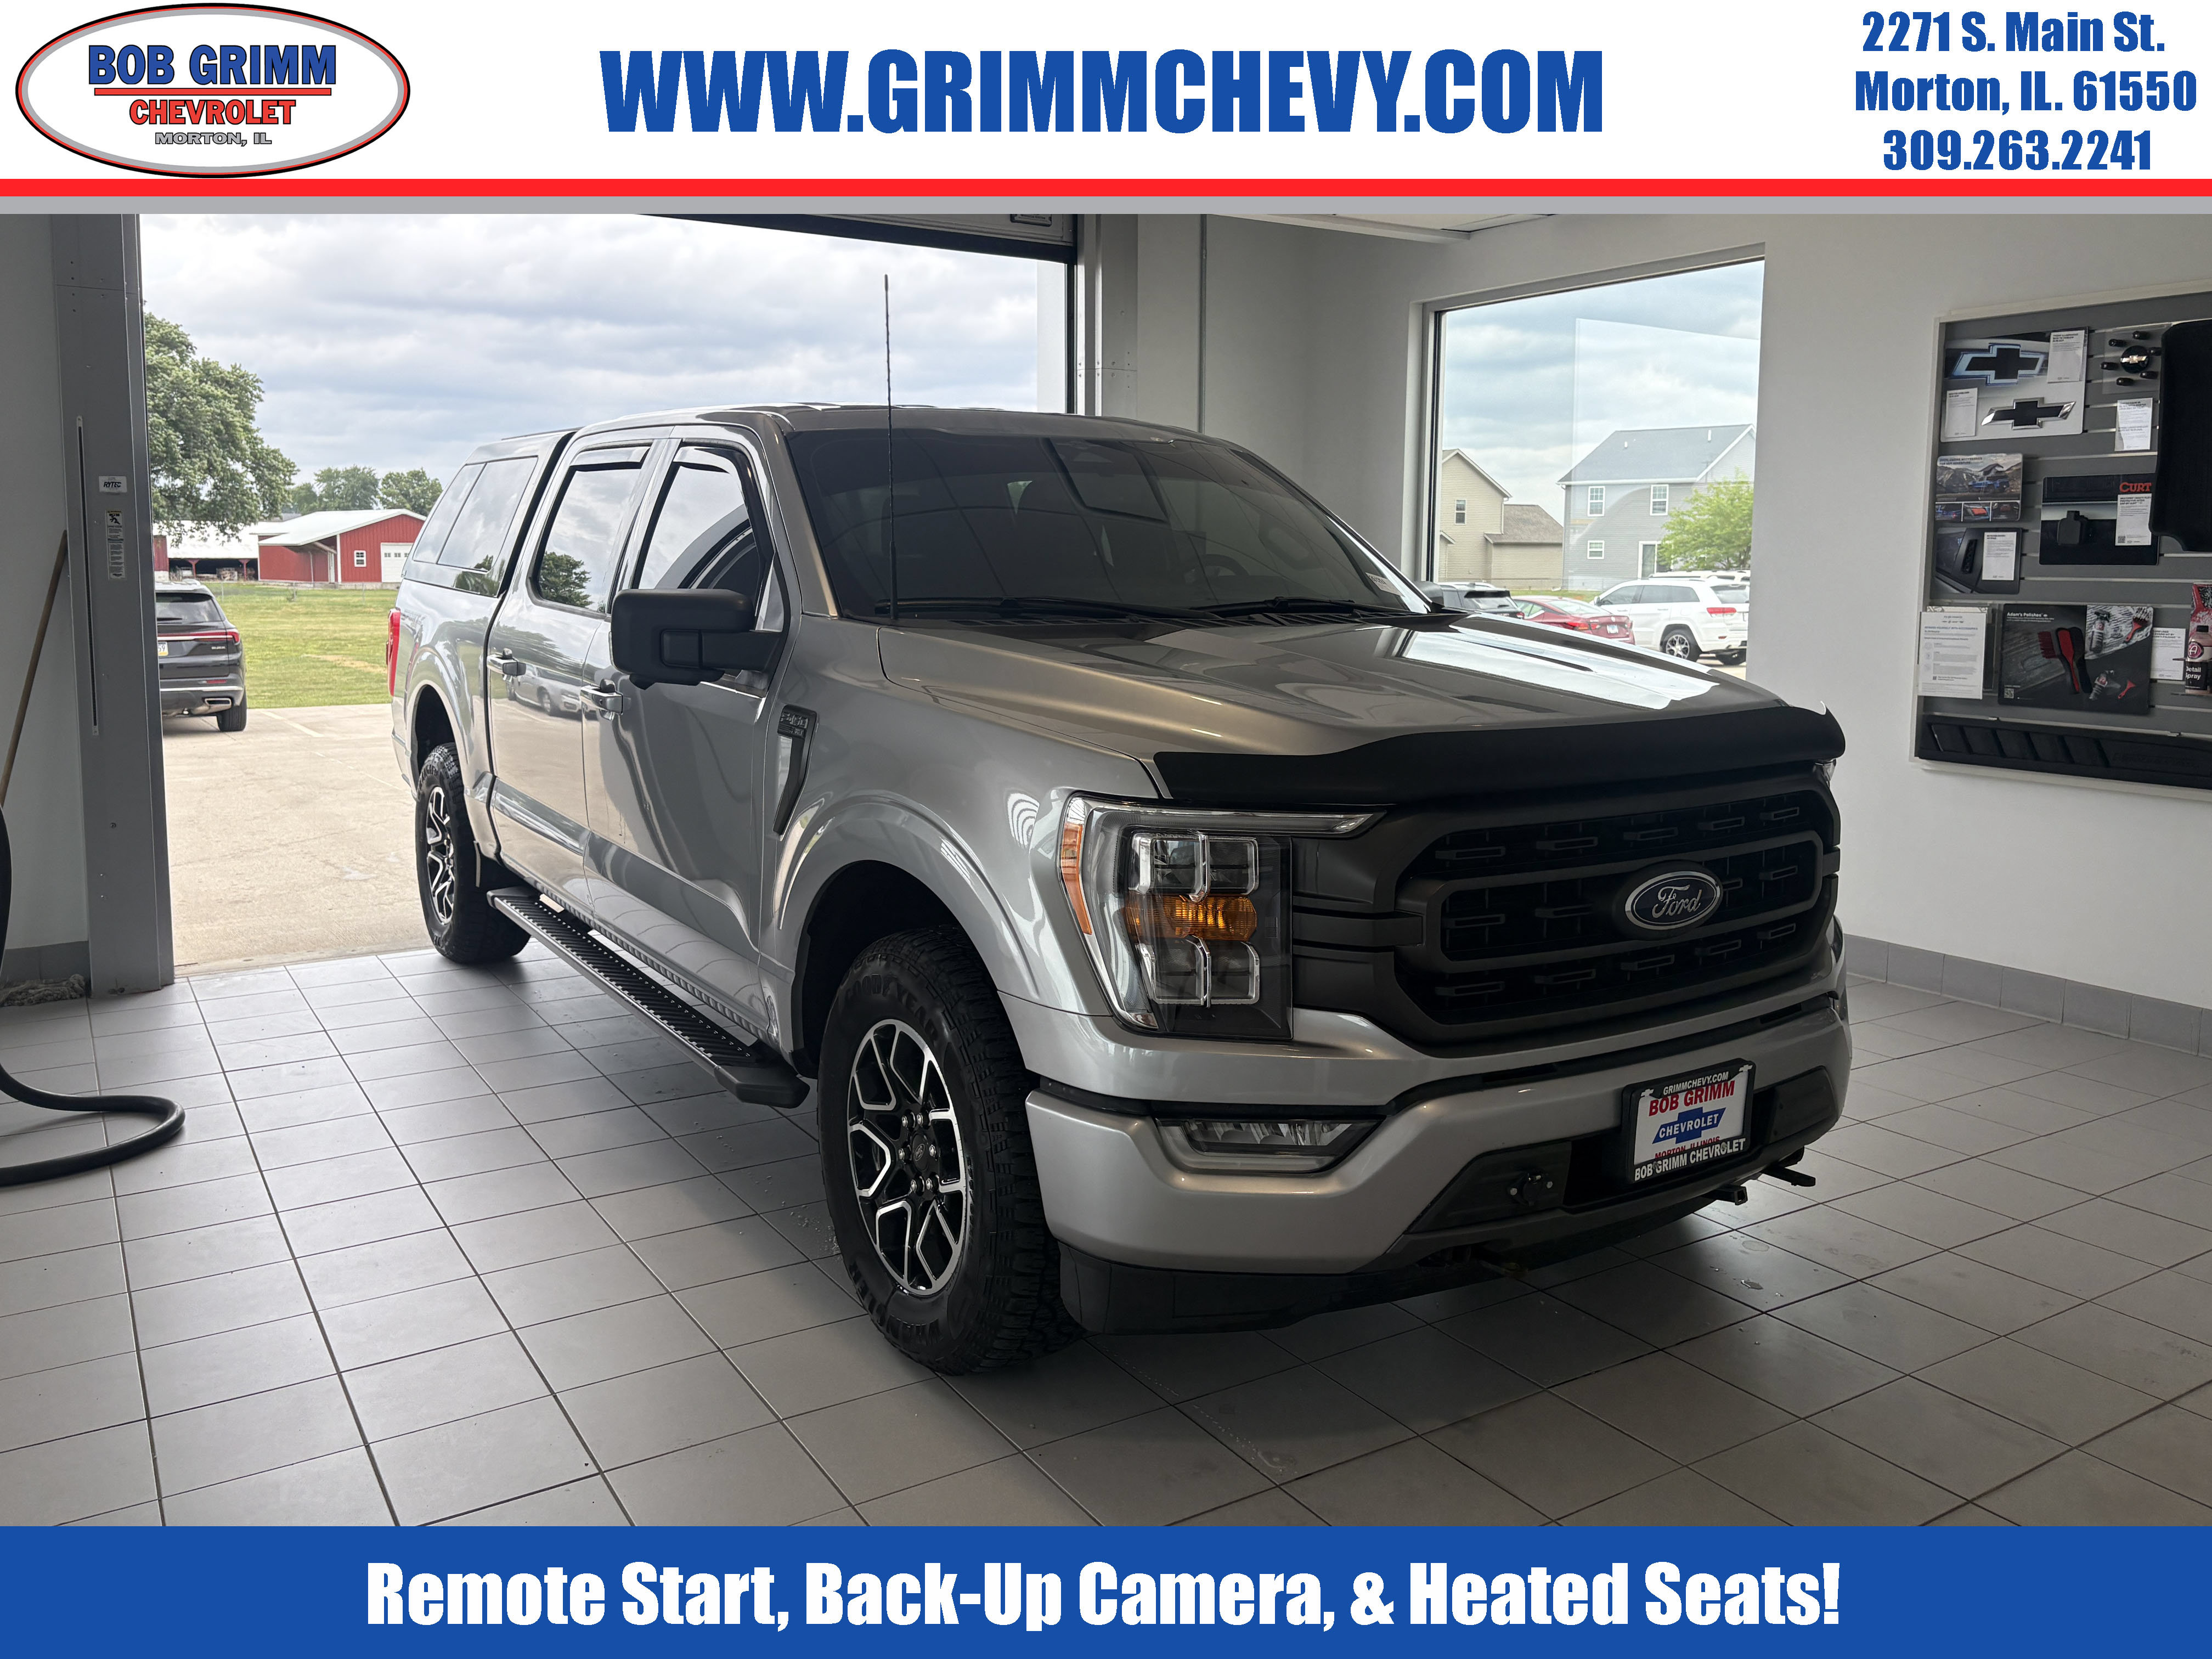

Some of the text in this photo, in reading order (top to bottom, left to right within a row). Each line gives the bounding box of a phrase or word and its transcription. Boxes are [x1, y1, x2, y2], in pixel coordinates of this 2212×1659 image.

[2119, 482, 2153, 492] CURT
[1652, 884, 1702, 918] Ford
[1649, 1080, 1735, 1116] BOB GRIMM
[1663, 1071, 1729, 1096] GRIMMCHEVY.COM
[1659, 1114, 1719, 1139] CHEVROLET
[1634, 1138, 1746, 1181] BOB GRIMM CHEVROLET
